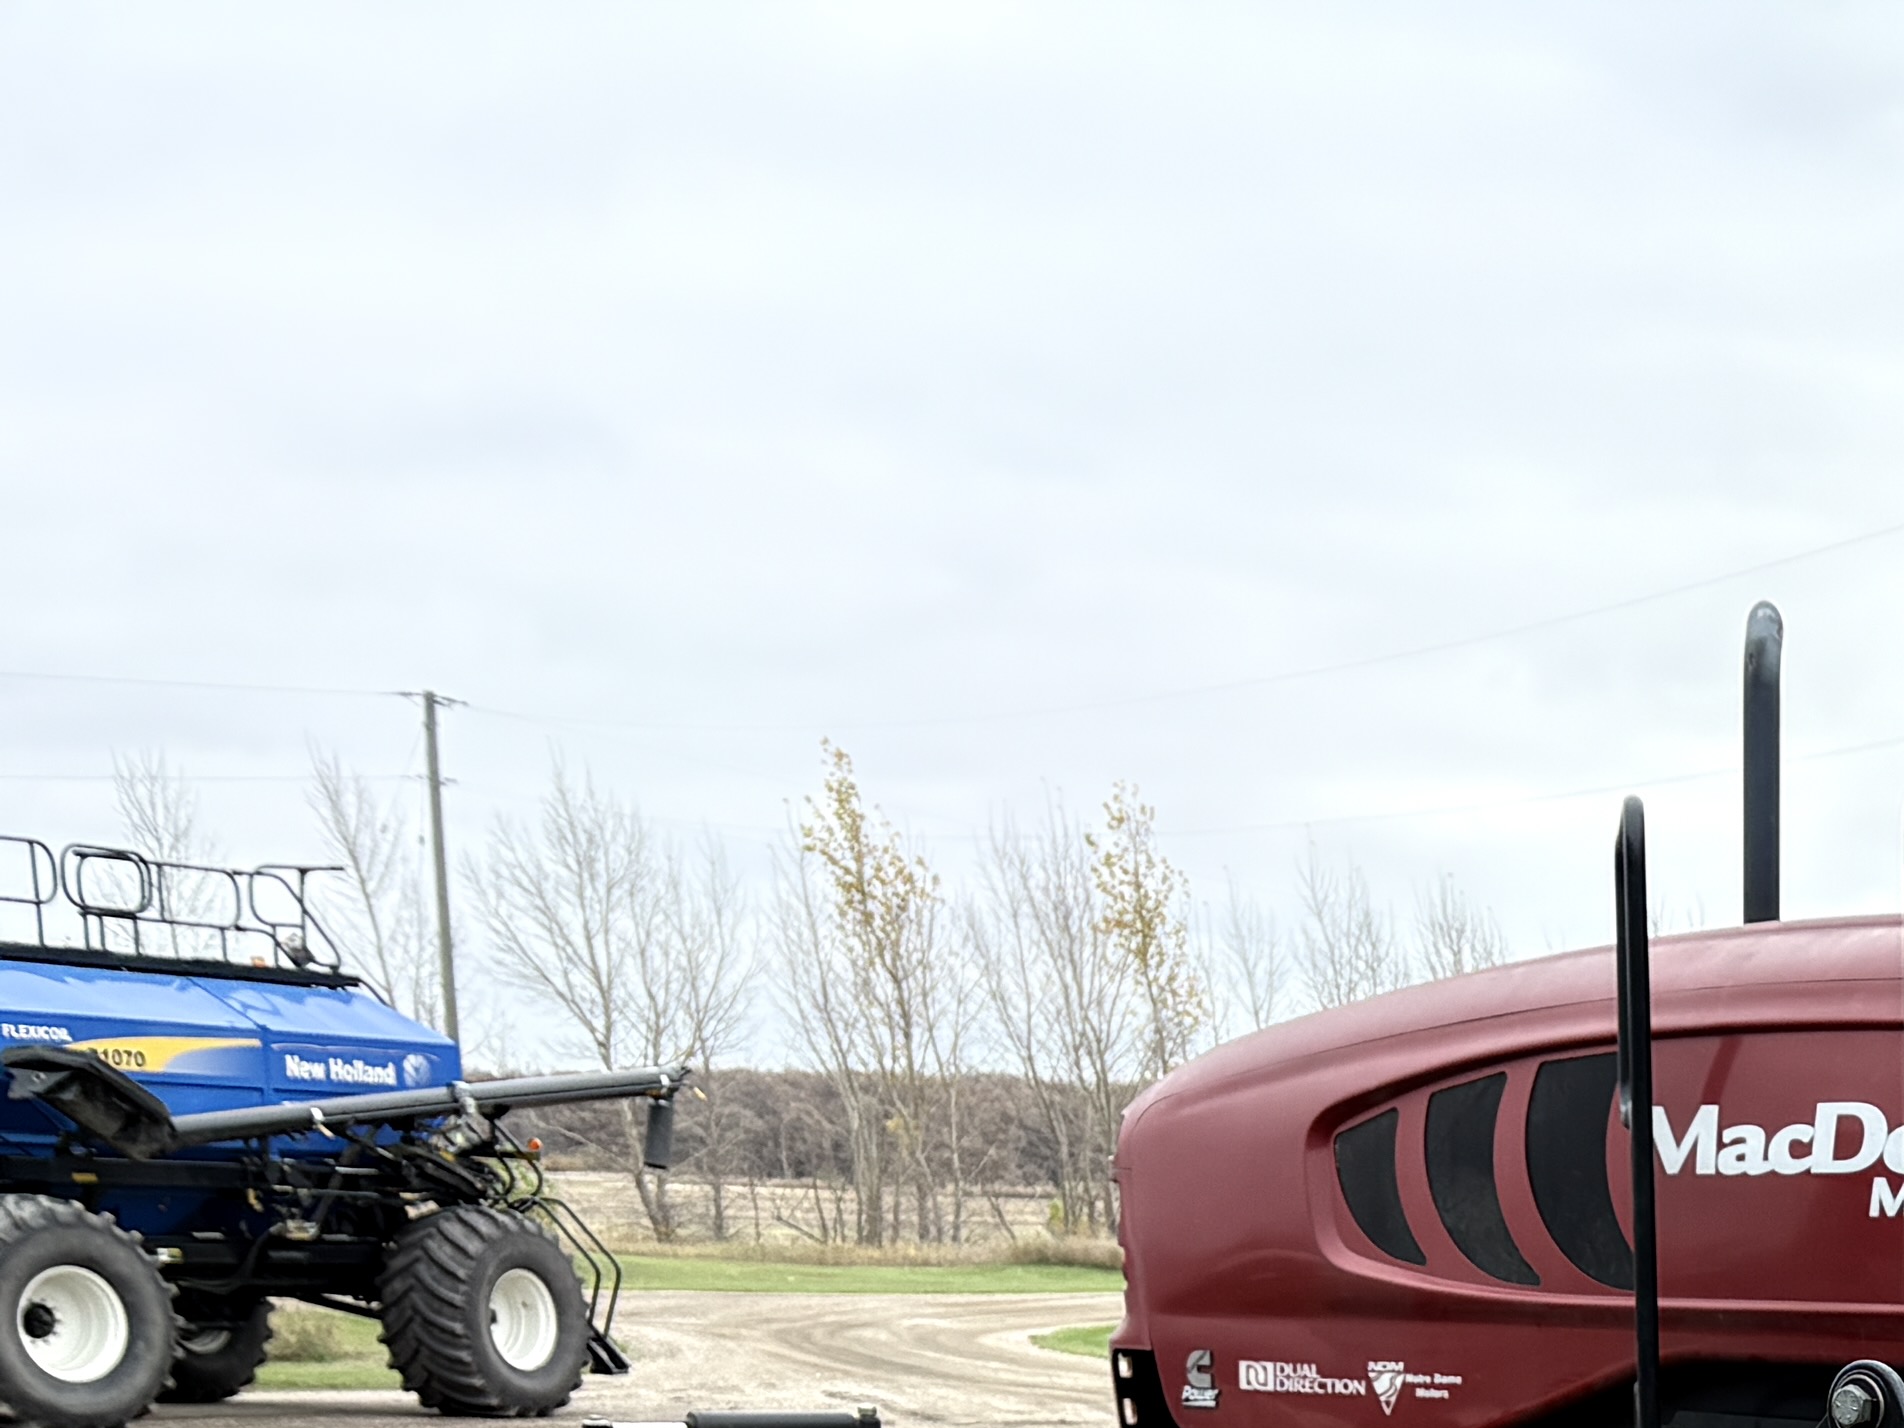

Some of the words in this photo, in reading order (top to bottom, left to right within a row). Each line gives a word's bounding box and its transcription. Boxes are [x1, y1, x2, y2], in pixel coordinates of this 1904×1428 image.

[285, 1054, 326, 1080] New
[328, 1058, 397, 1087] Holland
[1276, 1362, 1320, 1379] DUAL
[1276, 1377, 1366, 1396] DIRECTION
